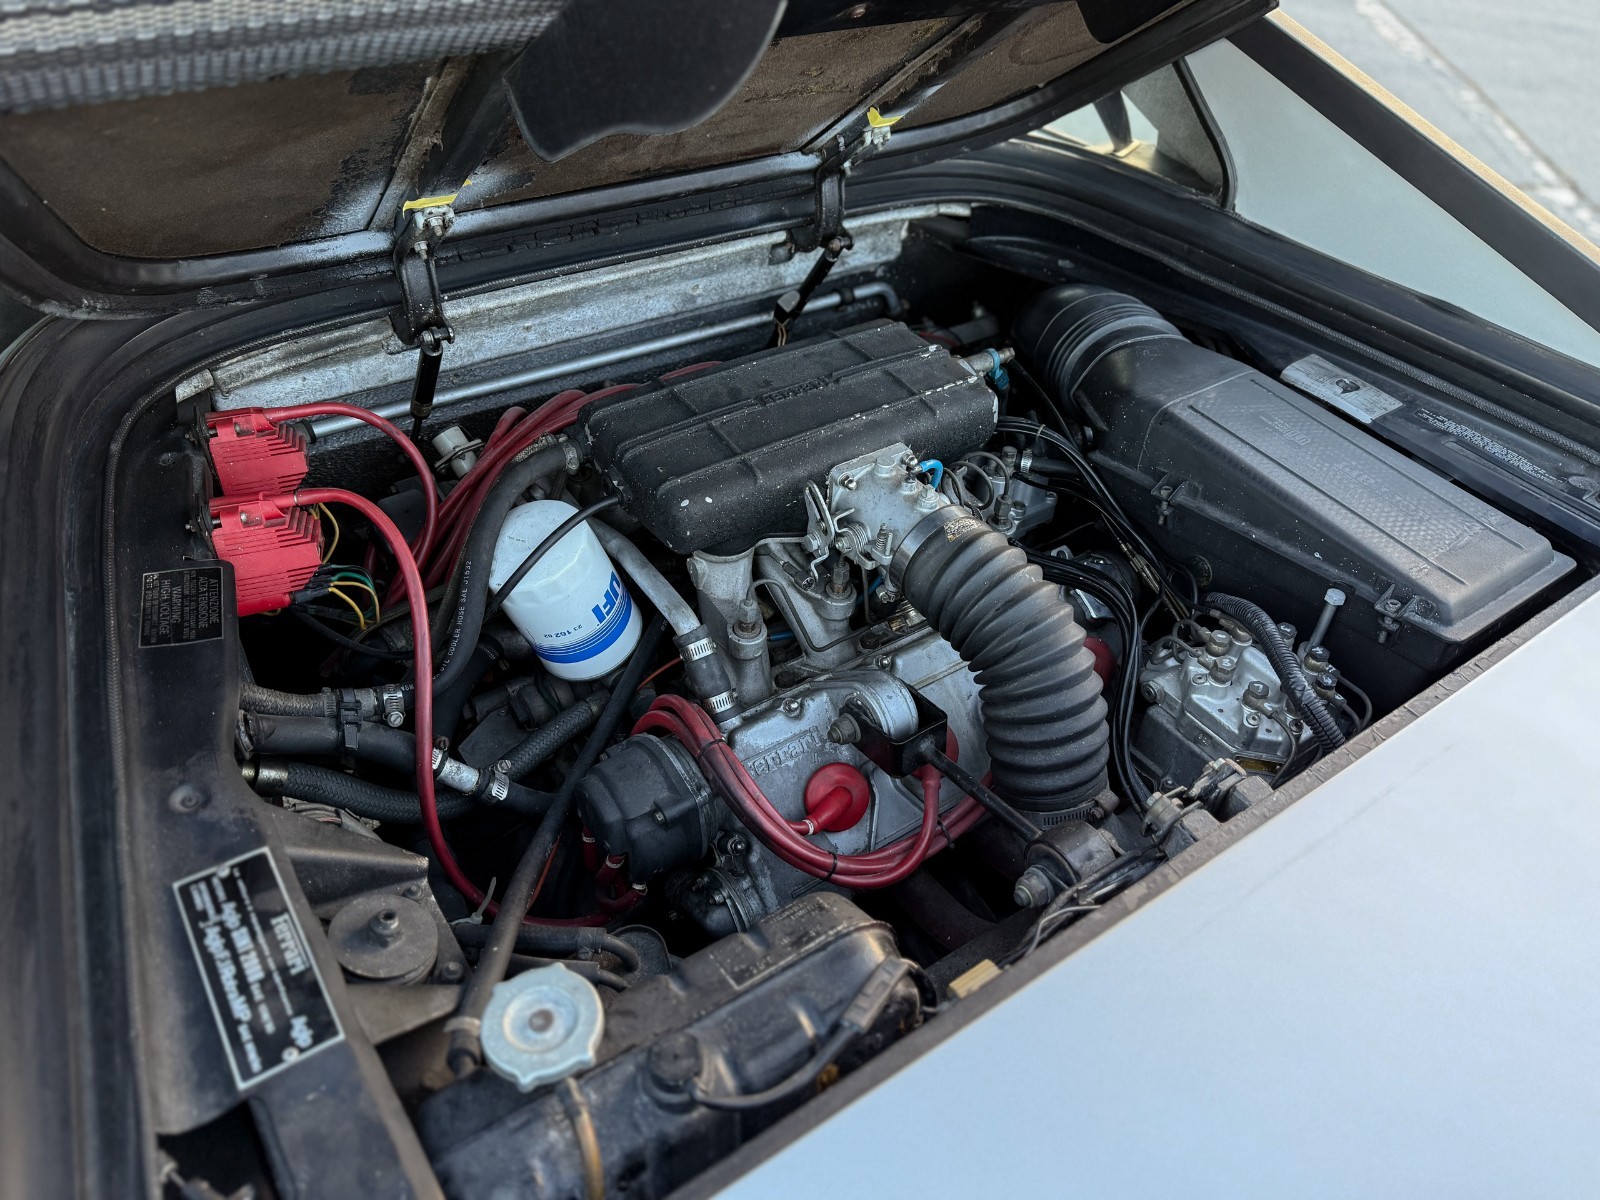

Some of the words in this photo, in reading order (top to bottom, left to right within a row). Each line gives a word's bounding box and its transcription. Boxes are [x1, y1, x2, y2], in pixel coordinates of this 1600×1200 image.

[160, 579, 171, 599] HIGH
[198, 576, 208, 592] ALTA
[460, 588, 468, 603] SAE
[591, 571, 621, 624] UFI
[159, 601, 171, 635] VOLTAGE
[171, 585, 182, 623] WARNING
[198, 593, 209, 629] TENSIONE
[208, 579, 220, 624] ATTENZIONE
[457, 606, 465, 625] HOSE
[447, 628, 461, 656] COOLER
[270, 912, 310, 976] Ferrari
